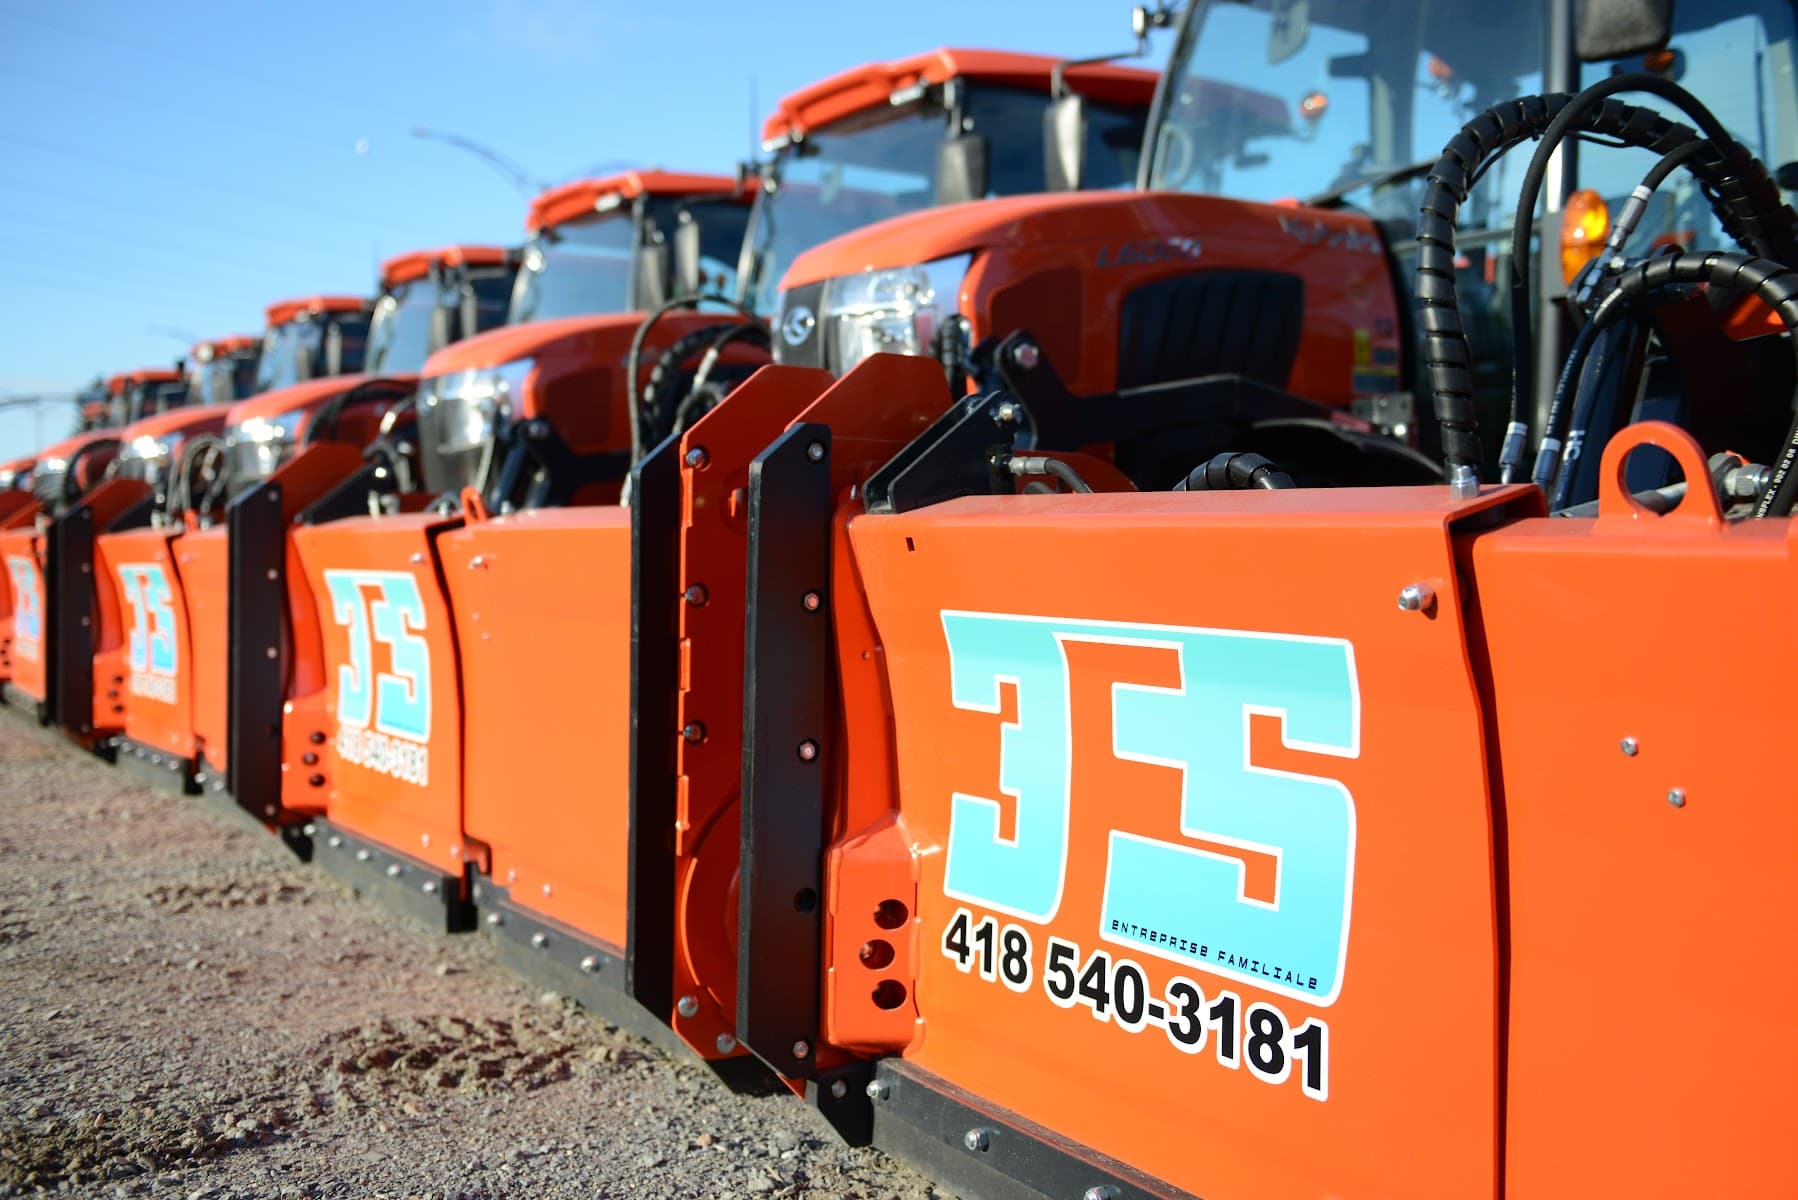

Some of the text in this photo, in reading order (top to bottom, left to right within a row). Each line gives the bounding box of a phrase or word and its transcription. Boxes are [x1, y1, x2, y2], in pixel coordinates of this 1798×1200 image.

[944, 912, 1324, 1094] 418 540-3181
[1111, 919, 1318, 990] ENTREPRISE FAMILIALE
